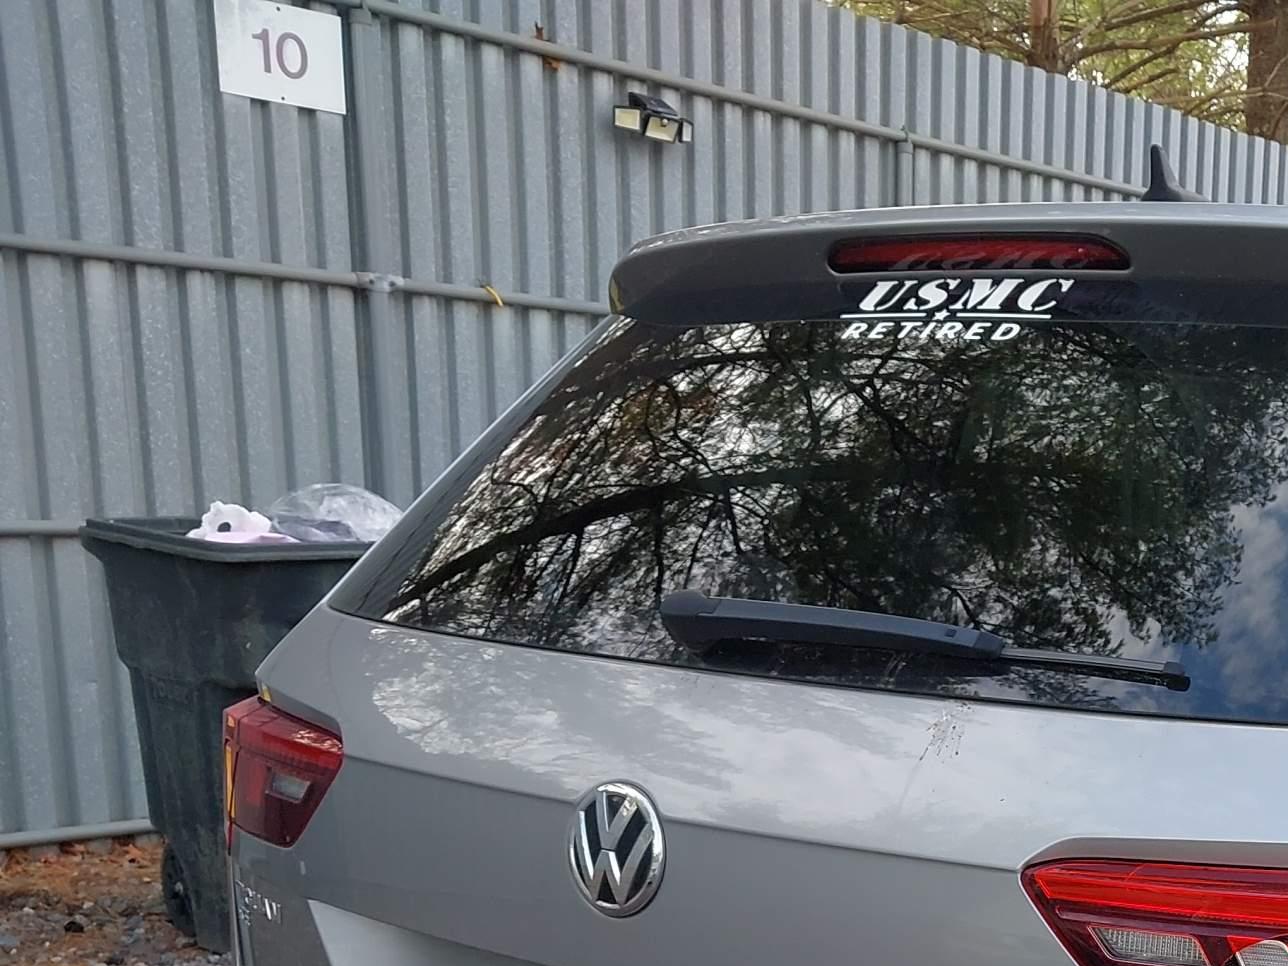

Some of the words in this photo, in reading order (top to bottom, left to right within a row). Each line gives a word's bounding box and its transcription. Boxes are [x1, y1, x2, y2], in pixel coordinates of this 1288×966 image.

[251, 27, 309, 80] 10
[858, 278, 1076, 312] USMC
[840, 321, 1022, 341] RETIRED
